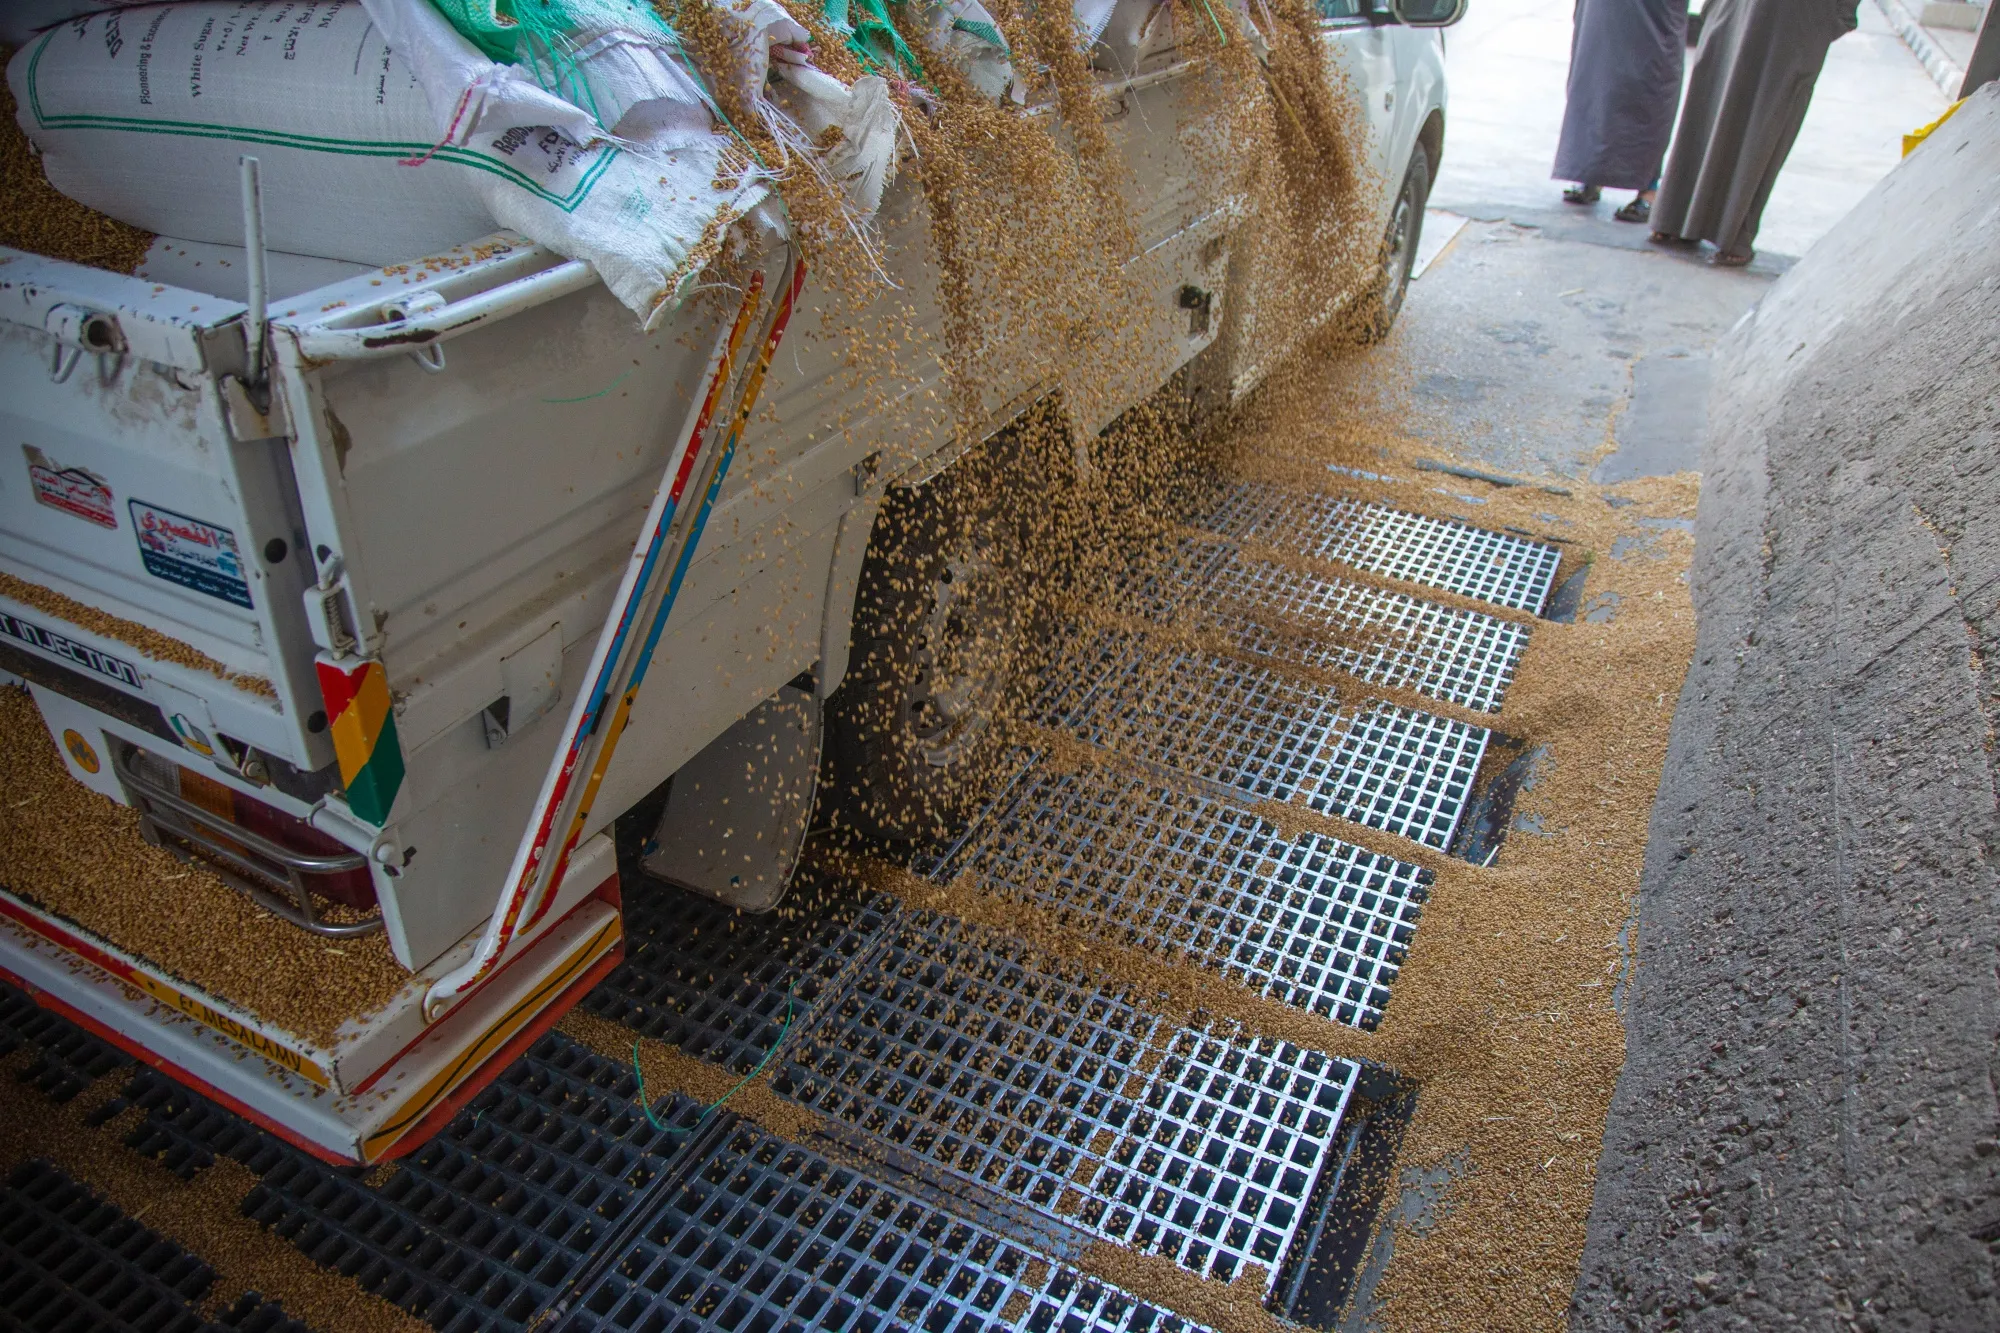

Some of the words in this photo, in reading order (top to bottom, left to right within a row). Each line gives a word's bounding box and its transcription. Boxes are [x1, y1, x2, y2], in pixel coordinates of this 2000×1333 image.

[143, 7, 174, 43] Excellence
[194, 17, 216, 51] Sugar
[144, 42, 152, 51] &
[236, 35, 249, 56] Net
[137, 52, 152, 105] Pioneering
[190, 54, 203, 98] White
[15, 619, 141, 687] INJECTION
